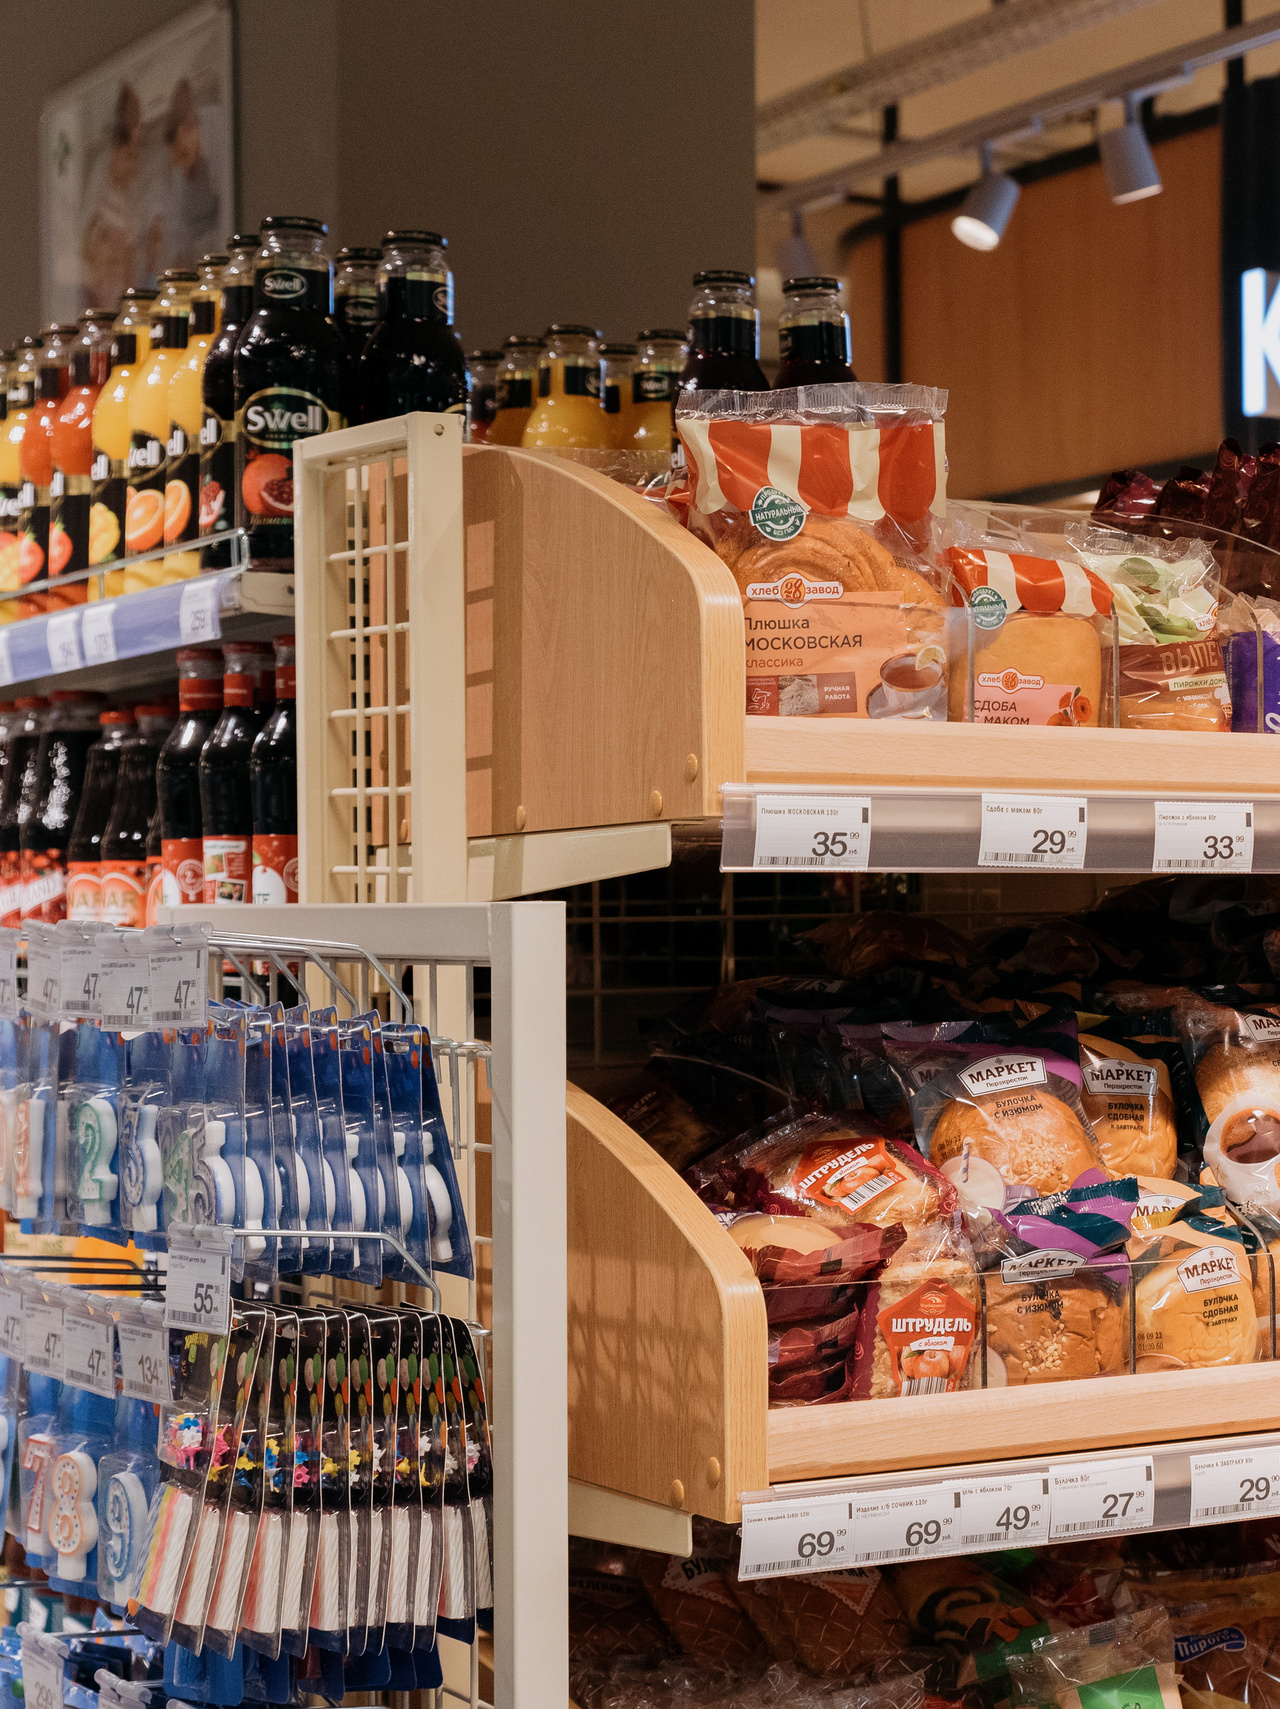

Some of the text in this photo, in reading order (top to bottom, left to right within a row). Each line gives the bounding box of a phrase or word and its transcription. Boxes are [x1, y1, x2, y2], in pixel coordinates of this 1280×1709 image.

[264, 275, 302, 294] Swell
[246, 404, 324, 434] Swell
[751, 586, 779, 596] хлеб
[805, 585, 839, 596] завод
[1173, 680, 1208, 689] ПИРОЖКИ
[973, 699, 1018, 712] СДОБА
[984, 716, 1031, 726] МАКОМ
[788, 808, 825, 816] МОСКОВСКАЯ
[986, 805, 1004, 813] Сдоба
[811, 831, 848, 857] 35
[1031, 829, 1066, 854] 29
[1203, 835, 1234, 860] 33
[126, 986, 143, 1015] 47
[174, 980, 191, 1010] 47
[967, 1061, 1038, 1085] МАРКЕТ
[1090, 1067, 1154, 1083] МАРКЕТ
[995, 1094, 1037, 1109] БУЛОЧКА
[1107, 1102, 1145, 1112] БУЛОЧКА
[1002, 1103, 1044, 1118] ИЗЮМОМ
[1107, 1112, 1145, 1122] СДОБНАЯ
[799, 1141, 876, 1190] ШТРУДЕЛЬ
[1184, 1256, 1237, 1281] МАРКЕТ
[193, 1283, 214, 1315] 55
[1021, 1291, 1061, 1303] БУЛОЧКА
[1203, 1293, 1239, 1308] БУЛОЧКА
[1024, 1301, 1064, 1314] ИЗЮМОМ
[1202, 1304, 1239, 1319] СДОБНАЯ
[891, 1316, 972, 1334] ШТРУДЕЛЬ
[1211, 1316, 1239, 1327] ЗАВТРАКУ
[87, 1348, 101, 1377] 47
[1194, 1462, 1214, 1470] Булочка
[1054, 1477, 1079, 1485] Булочка
[1239, 1477, 1270, 1502] 29
[856, 1504, 880, 1513] Изделие
[891, 1501, 914, 1510] СОЧНИК
[1102, 1492, 1134, 1519] 27
[995, 1505, 1030, 1531] 49
[905, 1519, 941, 1547] 69
[797, 1531, 835, 1559] 69
